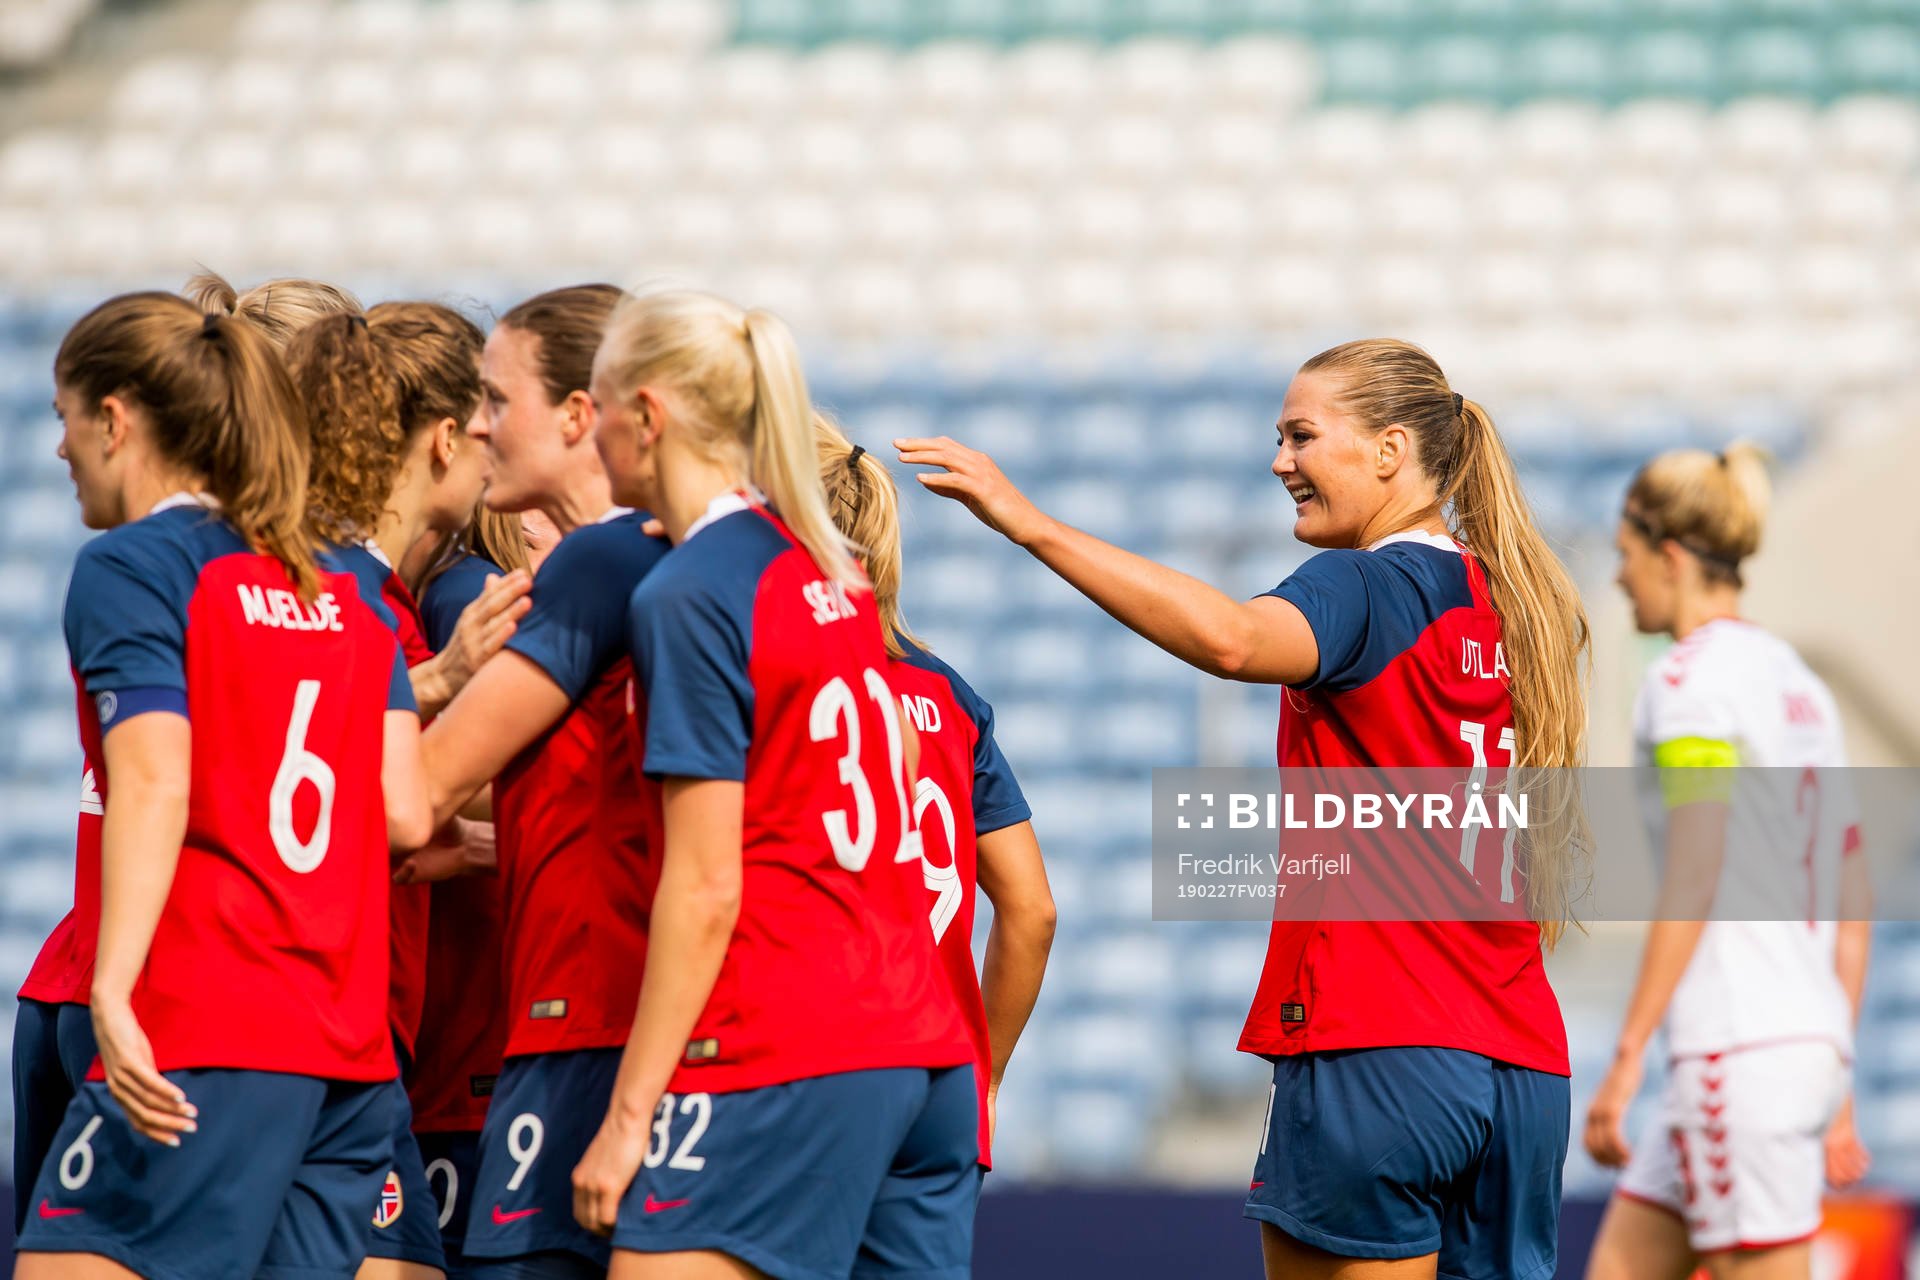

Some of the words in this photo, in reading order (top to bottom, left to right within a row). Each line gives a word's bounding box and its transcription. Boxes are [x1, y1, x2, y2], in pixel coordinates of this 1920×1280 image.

[237, 583, 344, 631] MJELDE
[269, 679, 336, 873] 6
[59, 1115, 103, 1191] 6
[506, 1113, 545, 1191] 9
[643, 1091, 712, 1172] 32
